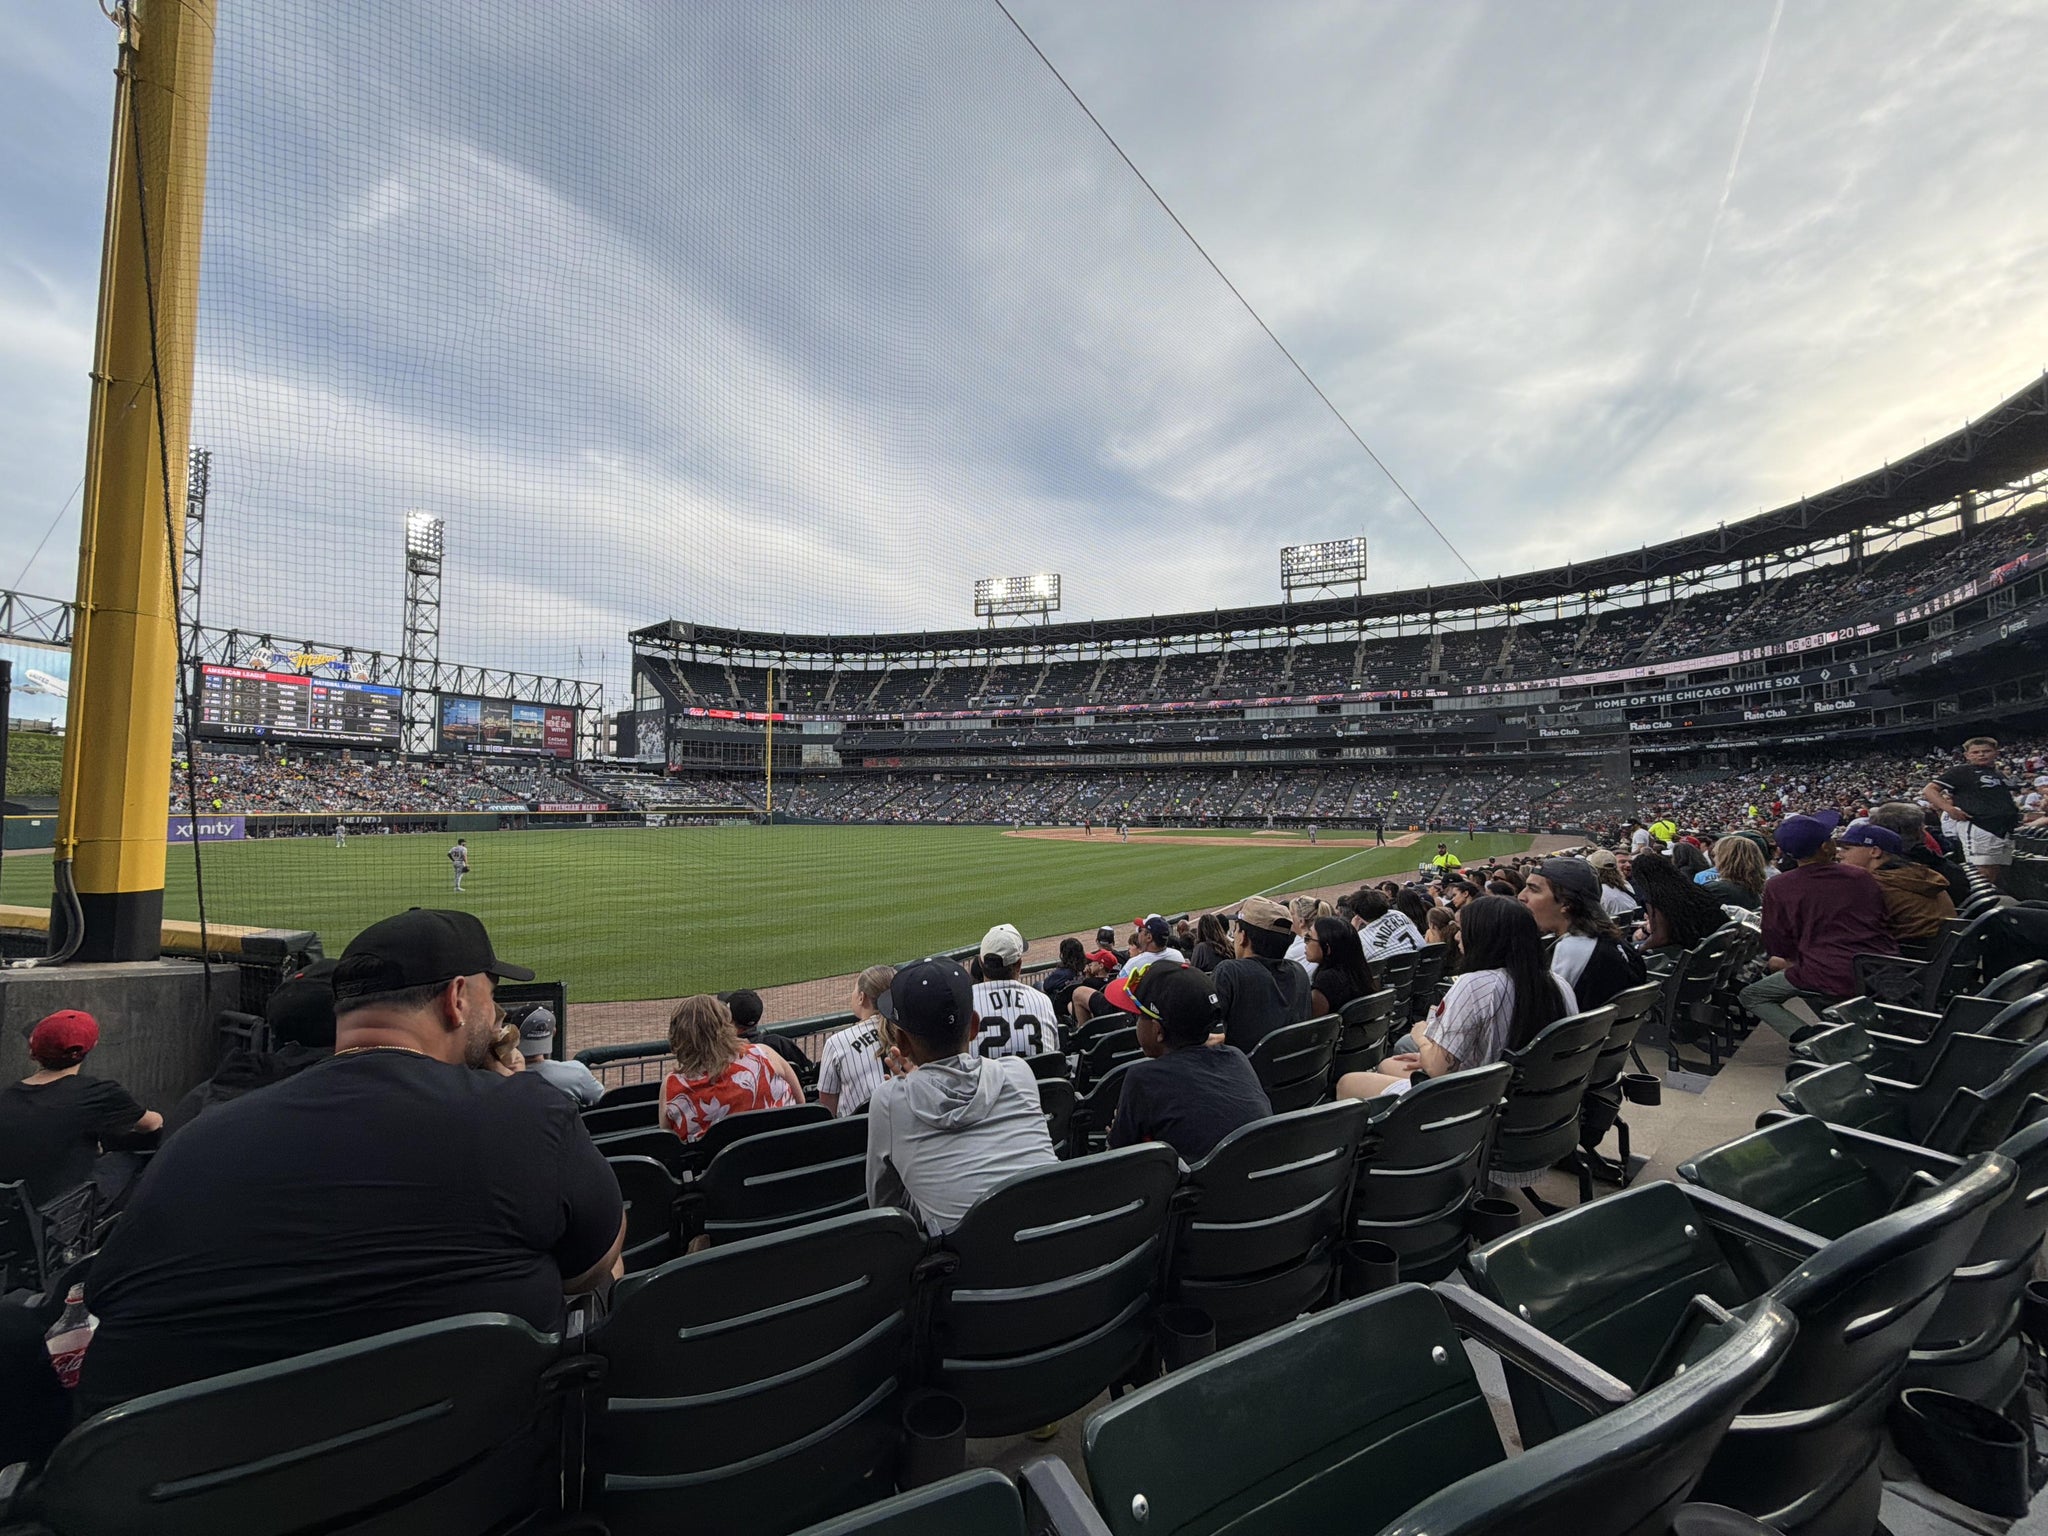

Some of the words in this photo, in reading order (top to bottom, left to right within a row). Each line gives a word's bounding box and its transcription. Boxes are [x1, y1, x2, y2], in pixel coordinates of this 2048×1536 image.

[1839, 627, 1854, 640] 20
[1858, 624, 1881, 636] VARGAS
[206, 667, 241, 676] AMERICAN
[242, 671, 266, 679] LEAGUE
[313, 680, 340, 688] NATIONAL
[1410, 690, 1423, 698] 52
[1595, 699, 1627, 709] HOME
[1630, 697, 1647, 706] OF
[1650, 693, 1673, 704] THE
[1676, 687, 1731, 701] CHICAGO
[1734, 678, 1772, 694] WHITE
[1775, 675, 1801, 688] SOX
[1814, 702, 1835, 713] Rate
[1835, 700, 1856, 710] Club
[1744, 710, 1765, 721] Rate
[1766, 708, 1787, 719] Club
[223, 726, 254, 734] SHIFT
[1630, 722, 1652, 731] Rate
[1652, 721, 1673, 730] Club
[1540, 729, 1559, 737] Rate
[1560, 728, 1580, 736] Club
[1397, 932, 1417, 950] 7
[989, 989, 1024, 1010] DYE
[948, 1015, 955, 1024] 3
[979, 1014, 1043, 1058] 23
